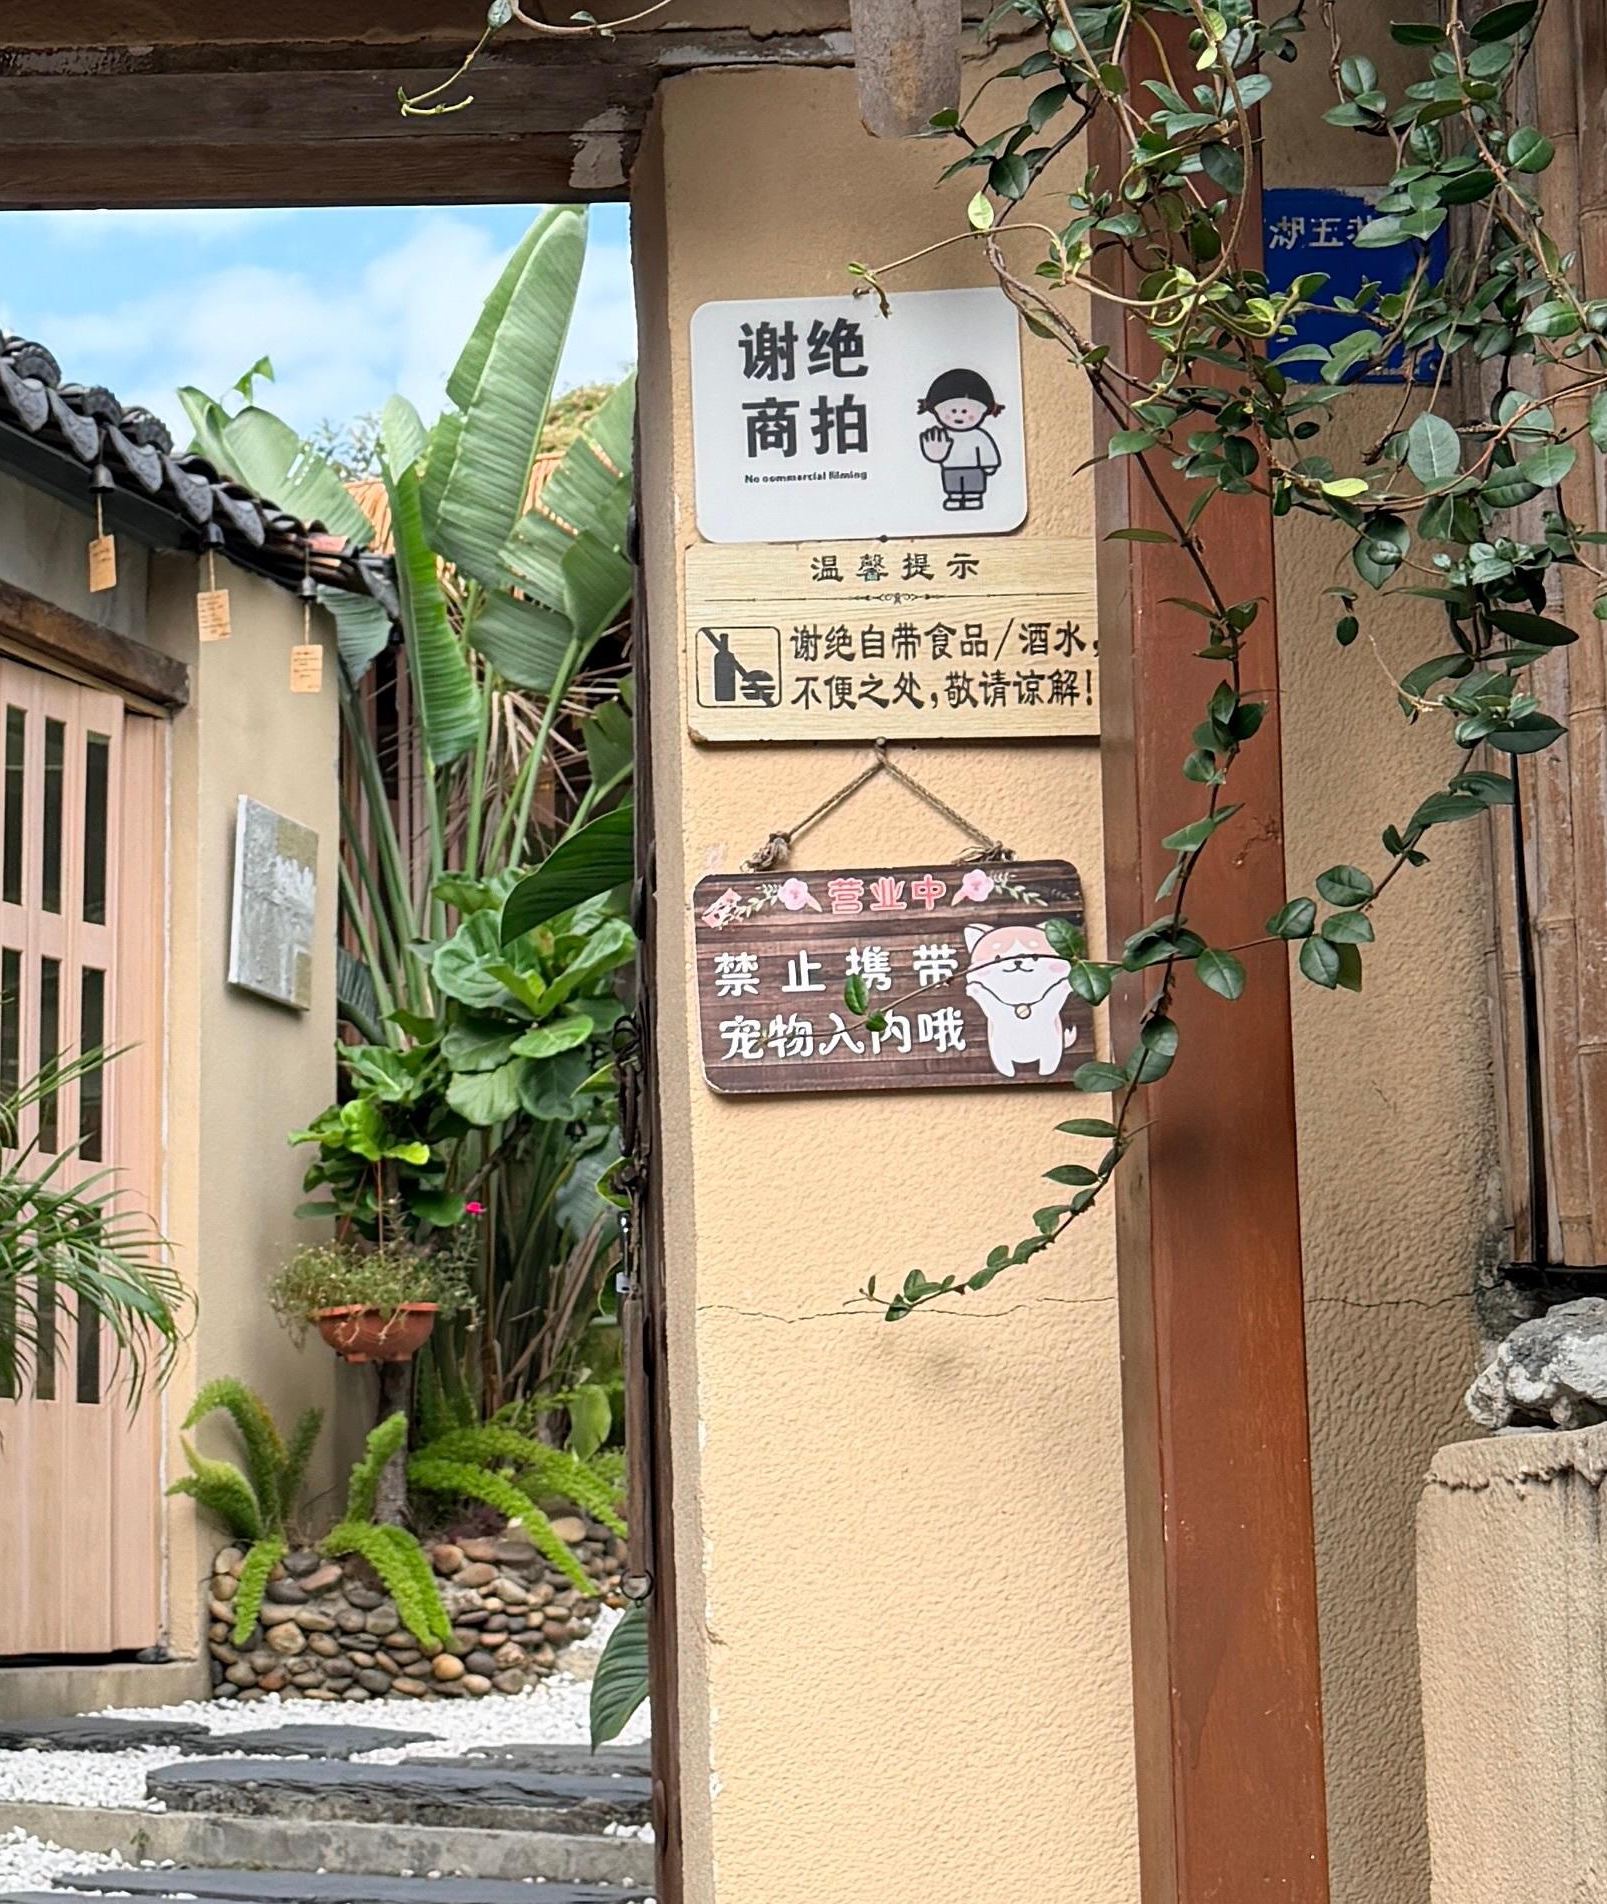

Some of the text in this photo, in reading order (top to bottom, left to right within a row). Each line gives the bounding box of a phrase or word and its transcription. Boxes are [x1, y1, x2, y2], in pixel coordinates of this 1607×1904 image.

[738, 317, 869, 382] 谢绝
[742, 393, 869, 458] 商拍
[744, 475, 760, 483] No
[762, 471, 826, 482] commercial
[810, 552, 980, 583] 温馨提示
[827, 873, 947, 915] 营业中
[714, 943, 959, 997] 禁止携带
[719, 1006, 966, 1060] 宠物入内哦
